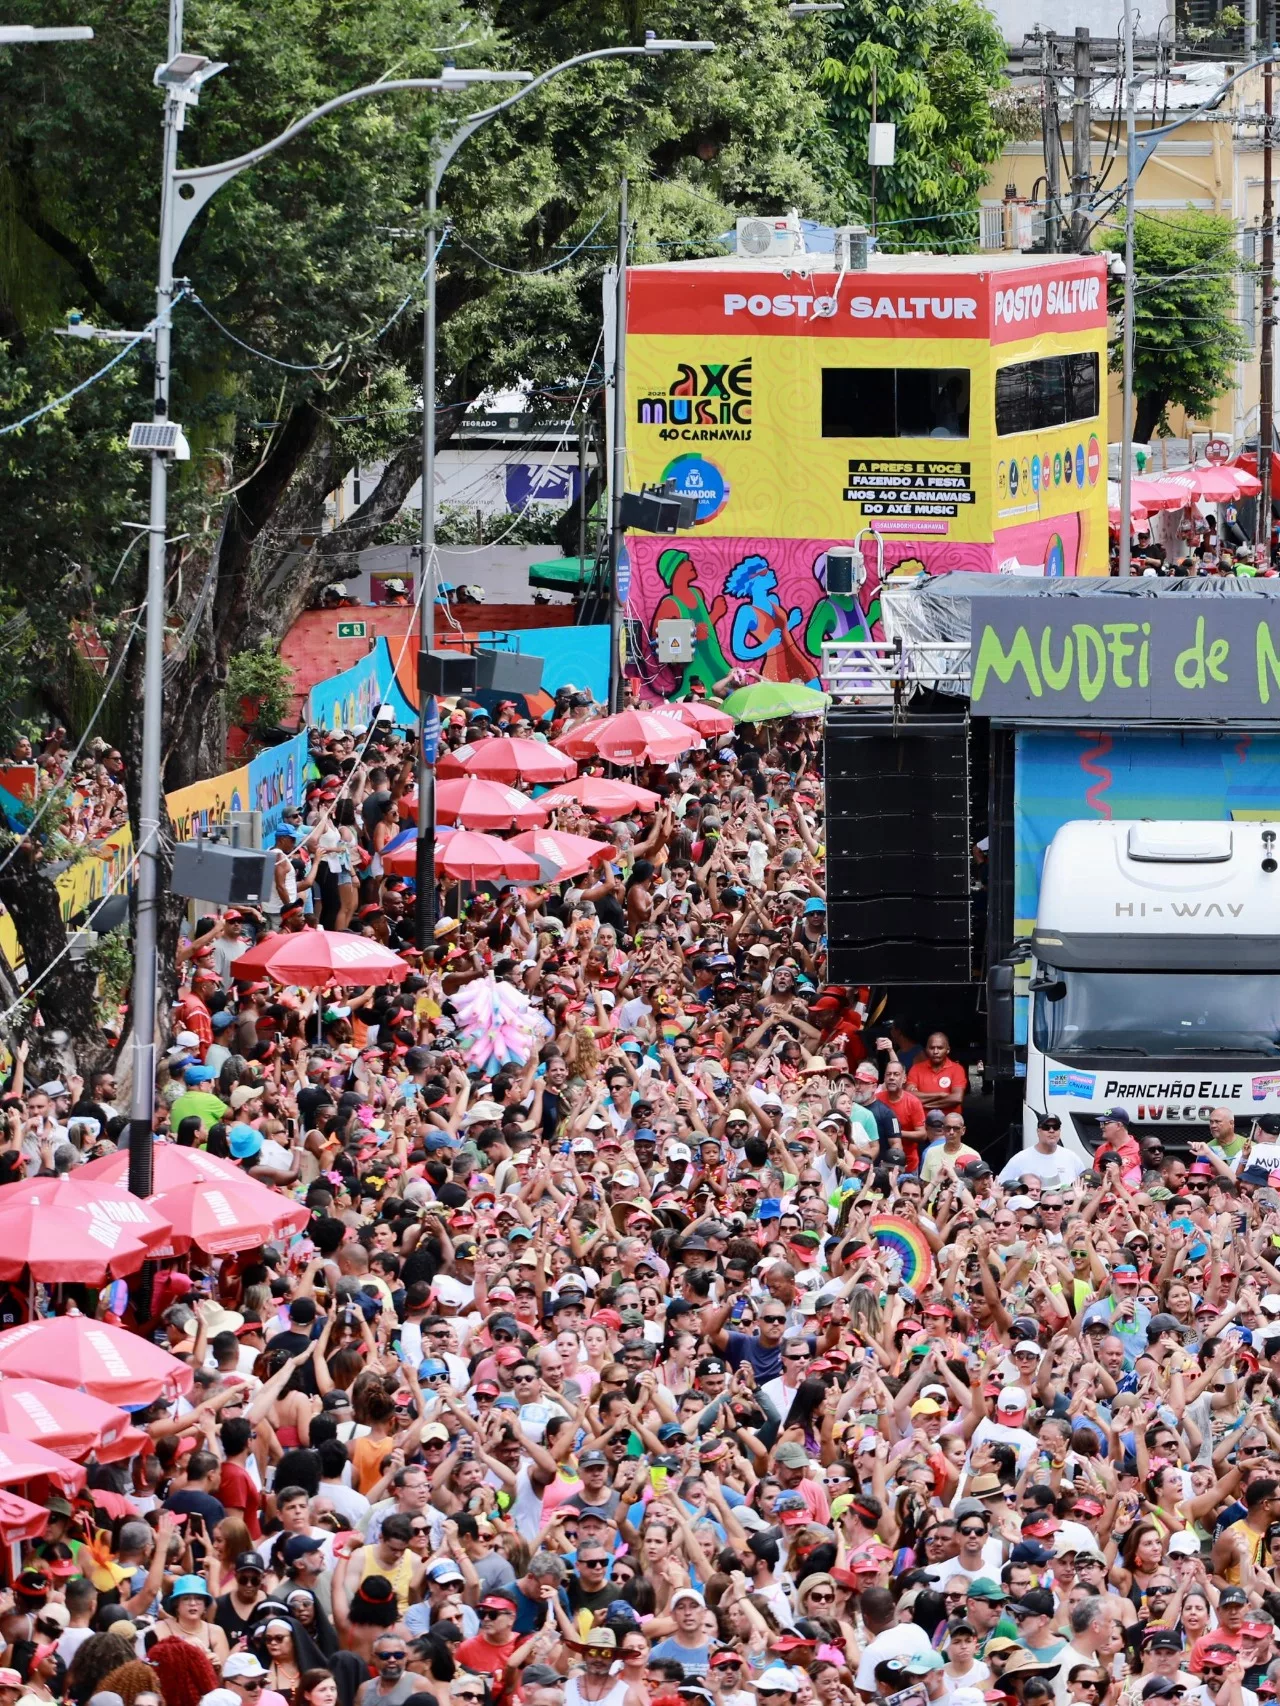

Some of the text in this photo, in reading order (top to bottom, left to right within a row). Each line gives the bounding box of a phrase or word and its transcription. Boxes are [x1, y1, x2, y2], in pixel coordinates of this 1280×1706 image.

[723, 293, 977, 320] POSTO SALTUR
[994, 276, 1100, 326] POSTO SALTUR
[659, 428, 752, 441] 40 CARNAVAIS
[858, 463, 962, 474] A PREFS E VOCÊ
[853, 476, 966, 488] FAZENDO A FESTA
[847, 490, 971, 502] NOS 40 CARNAVAIS
[863, 503, 955, 515] DO AXÉ MUSIC
[1175, 615, 1229, 689] de
[1115, 902, 1244, 917] HI-WAY
[1137, 1104, 1216, 1121] IVECO
